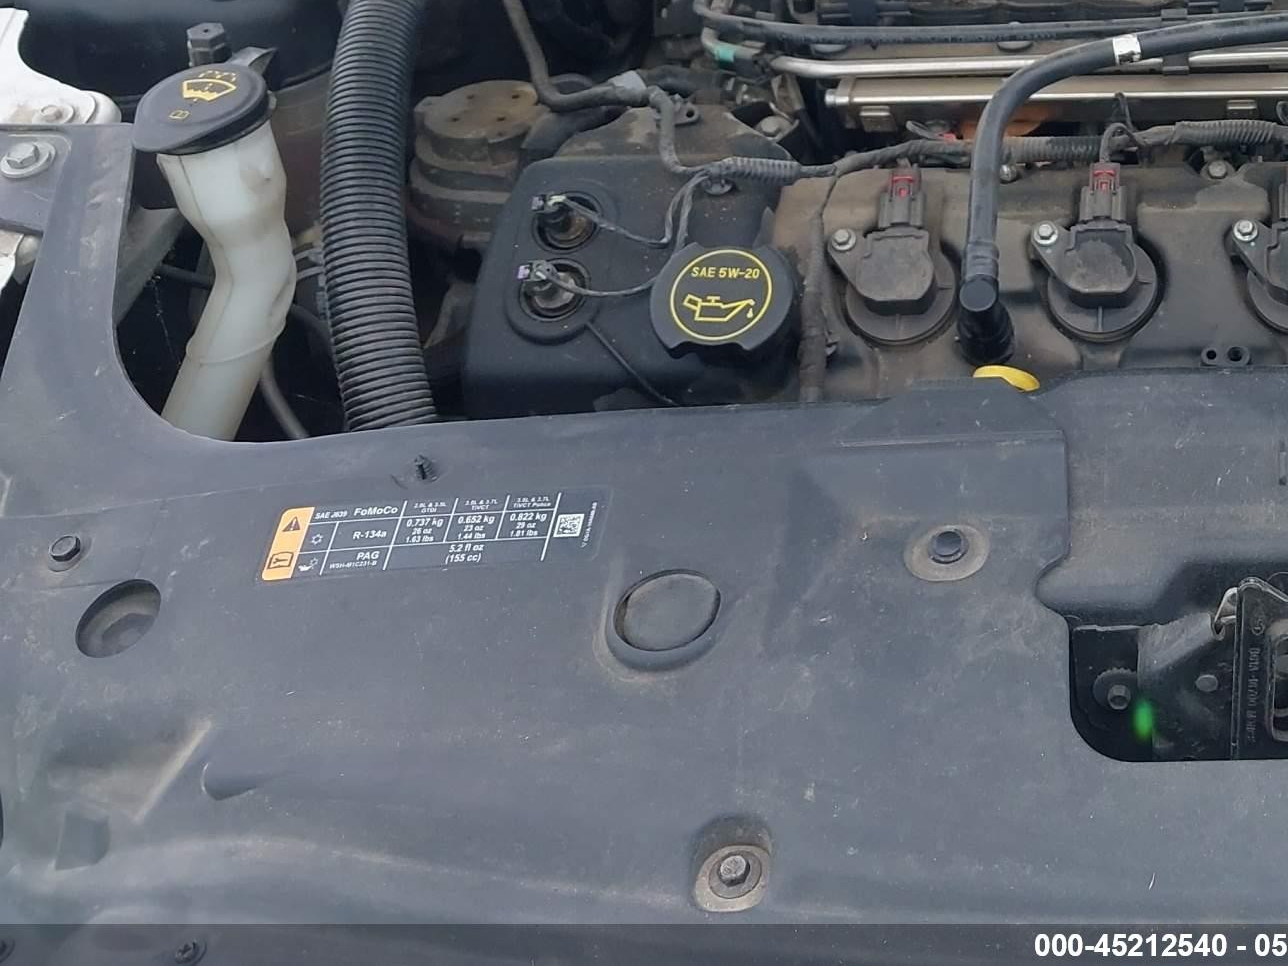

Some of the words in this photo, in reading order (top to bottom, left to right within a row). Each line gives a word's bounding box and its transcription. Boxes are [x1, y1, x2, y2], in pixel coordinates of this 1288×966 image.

[691, 267, 716, 278] SAE
[718, 267, 760, 279] 5W-20
[315, 512, 330, 520] SAE
[353, 506, 398, 516] FoMoCo
[457, 515, 482, 524] 0.652
[483, 514, 496, 525] kg
[510, 513, 534, 522] 0.822
[535, 512, 547, 522] kg
[406, 518, 431, 527] 0.737
[432, 517, 444, 528] kg
[352, 530, 387, 540] R-134a
[449, 544, 463, 553] 5.2
[464, 543, 472, 552] fl
[356, 551, 380, 561] PAG
[445, 554, 466, 565] (155
[466, 553, 482, 563] cc)
